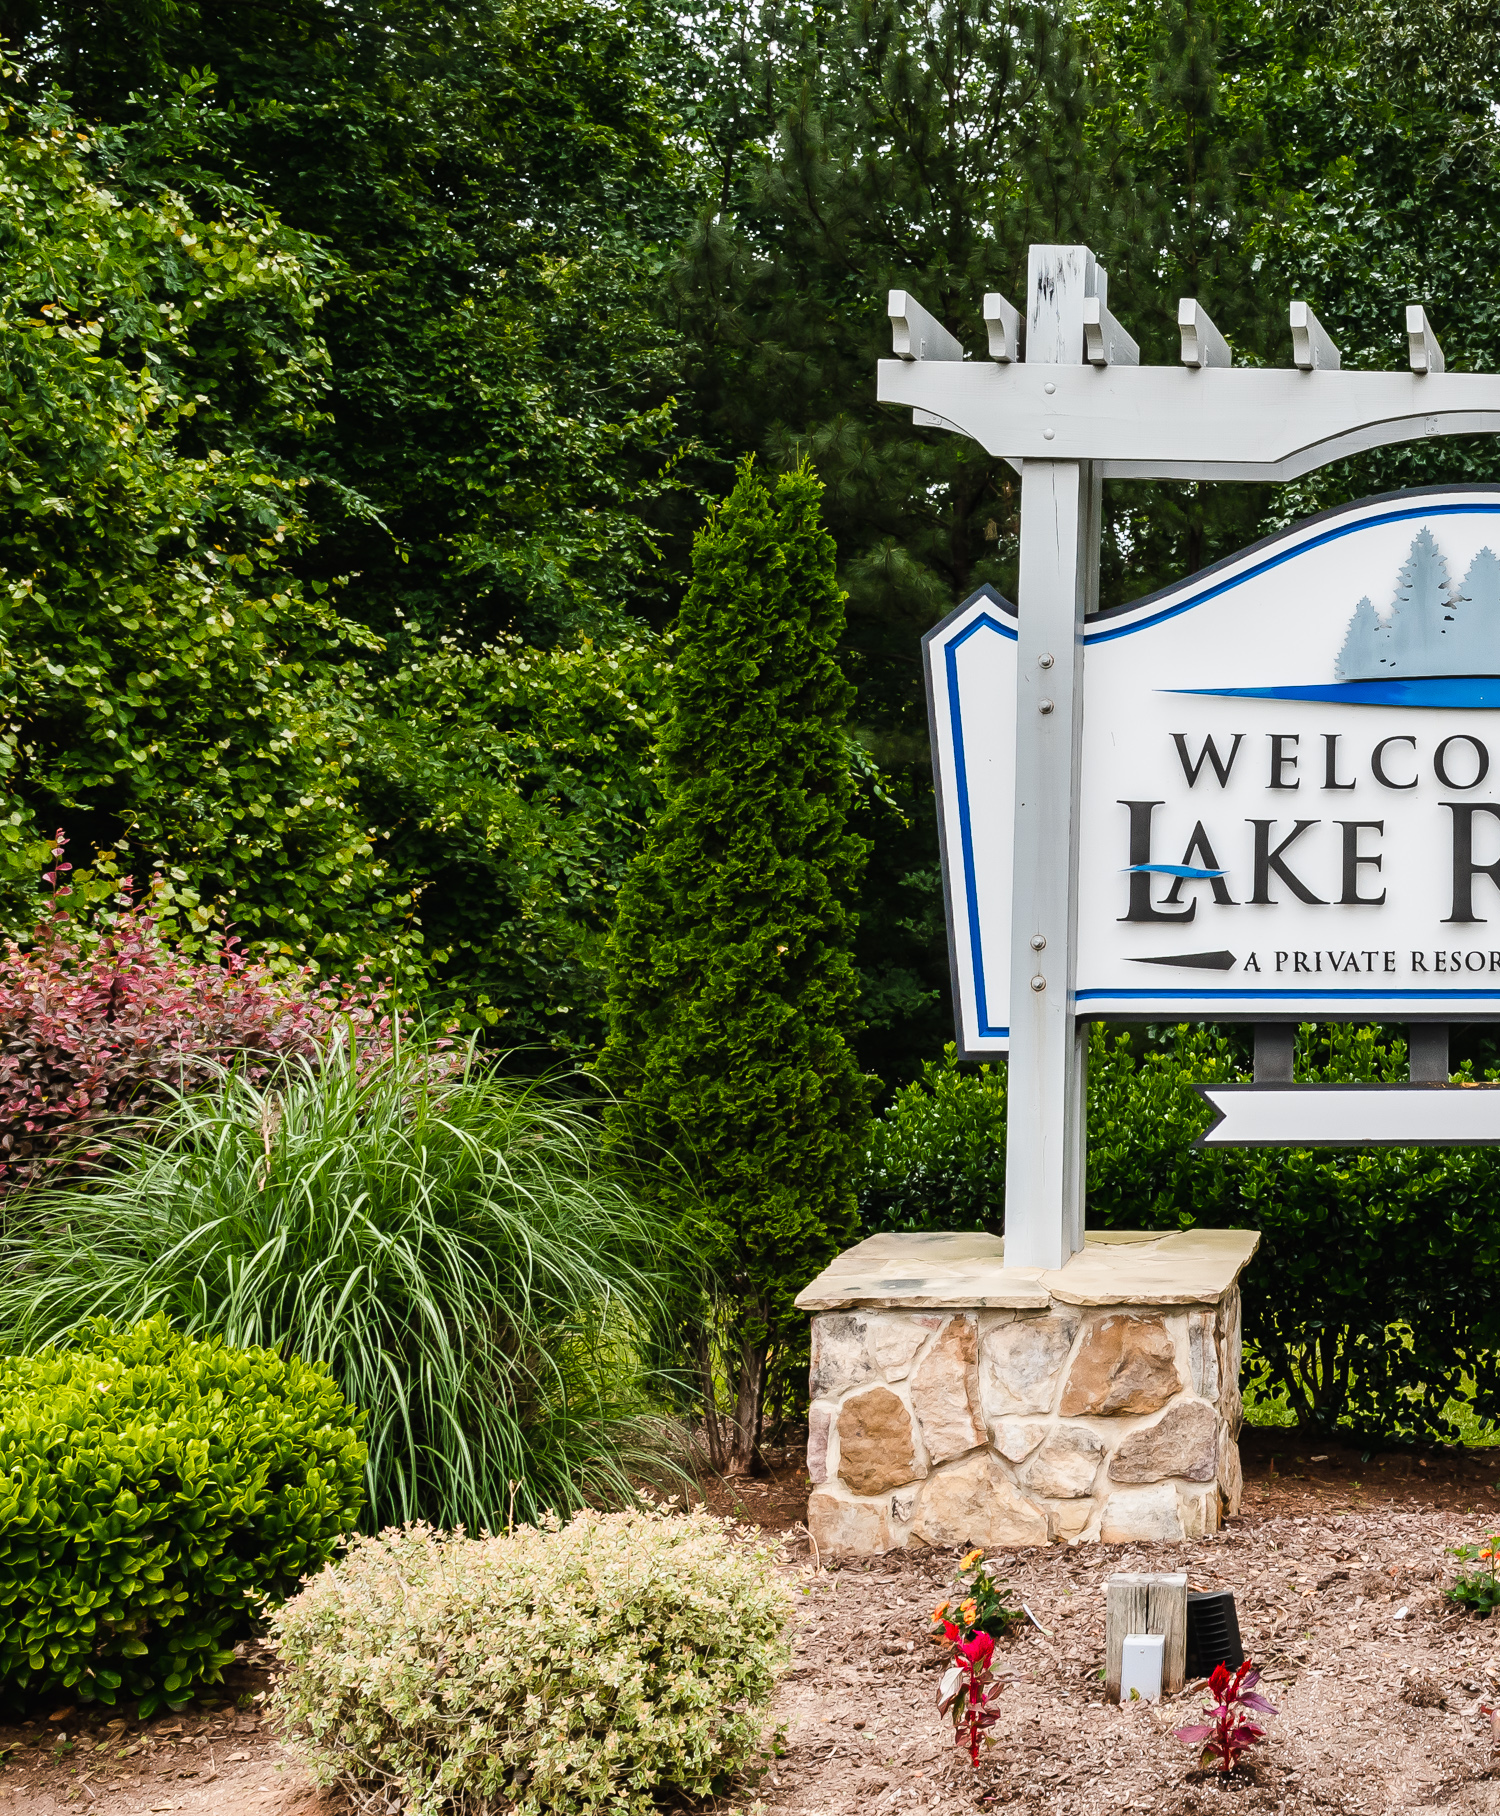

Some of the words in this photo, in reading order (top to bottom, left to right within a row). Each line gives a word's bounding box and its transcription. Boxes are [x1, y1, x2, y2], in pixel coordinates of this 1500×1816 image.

[1116, 799, 1387, 925] LAKE
[1243, 950, 1262, 973] A
[1274, 950, 1396, 973] PRIVATE
